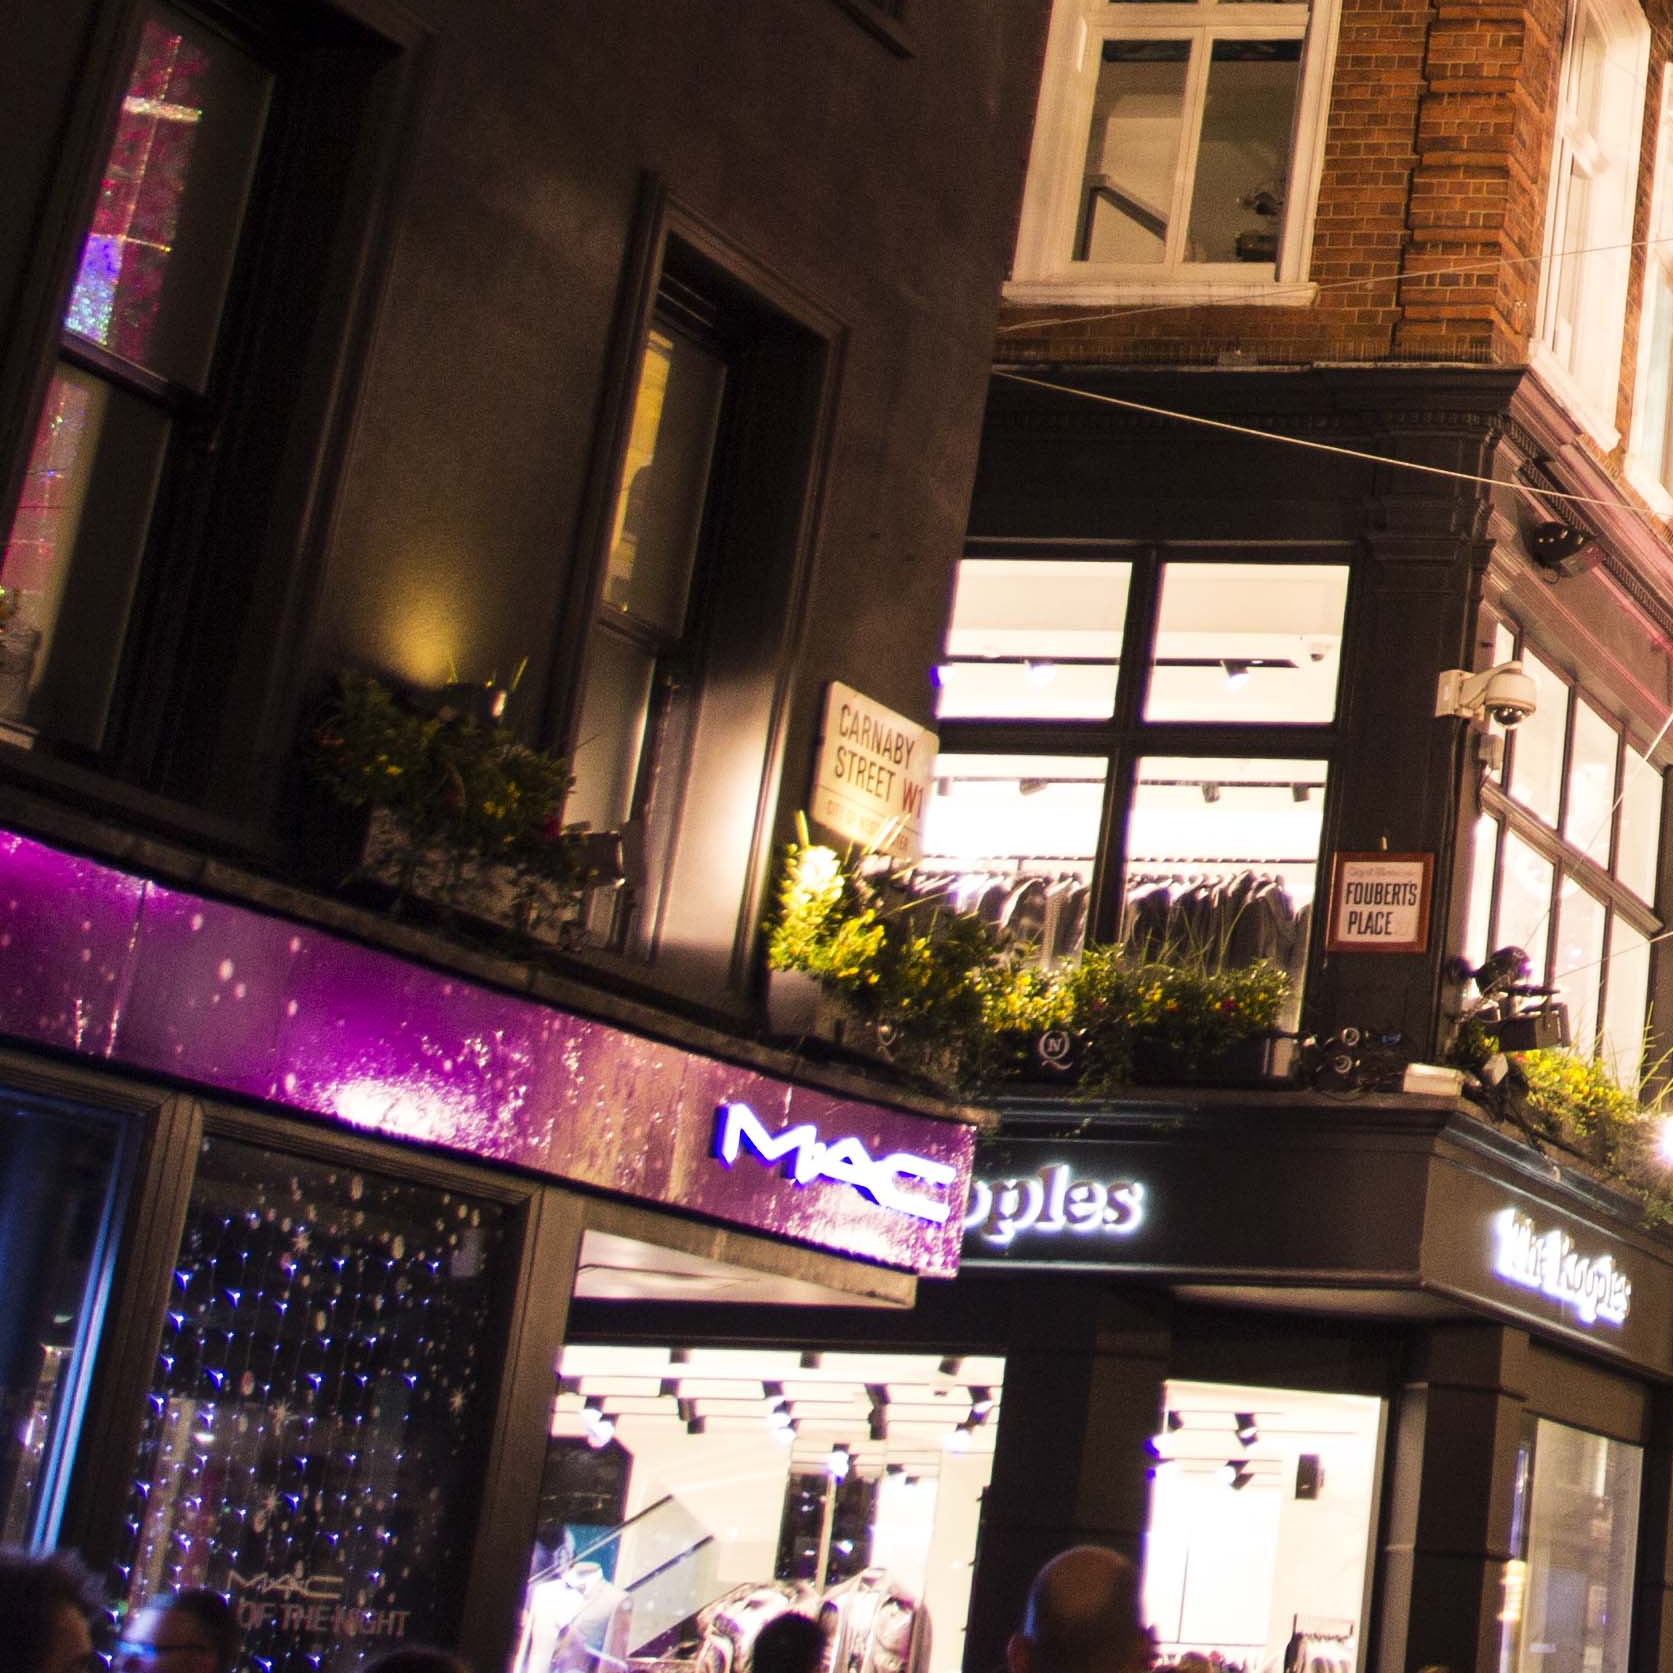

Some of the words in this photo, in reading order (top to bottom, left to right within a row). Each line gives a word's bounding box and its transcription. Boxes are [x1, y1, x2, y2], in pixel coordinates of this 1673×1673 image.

[839, 703, 916, 771] CARNABY
[834, 745, 896, 802] STREET
[1345, 880, 1418, 906] FOUBERT'S
[1347, 910, 1393, 936] PLACE
[280, 1604, 331, 1633] THE
